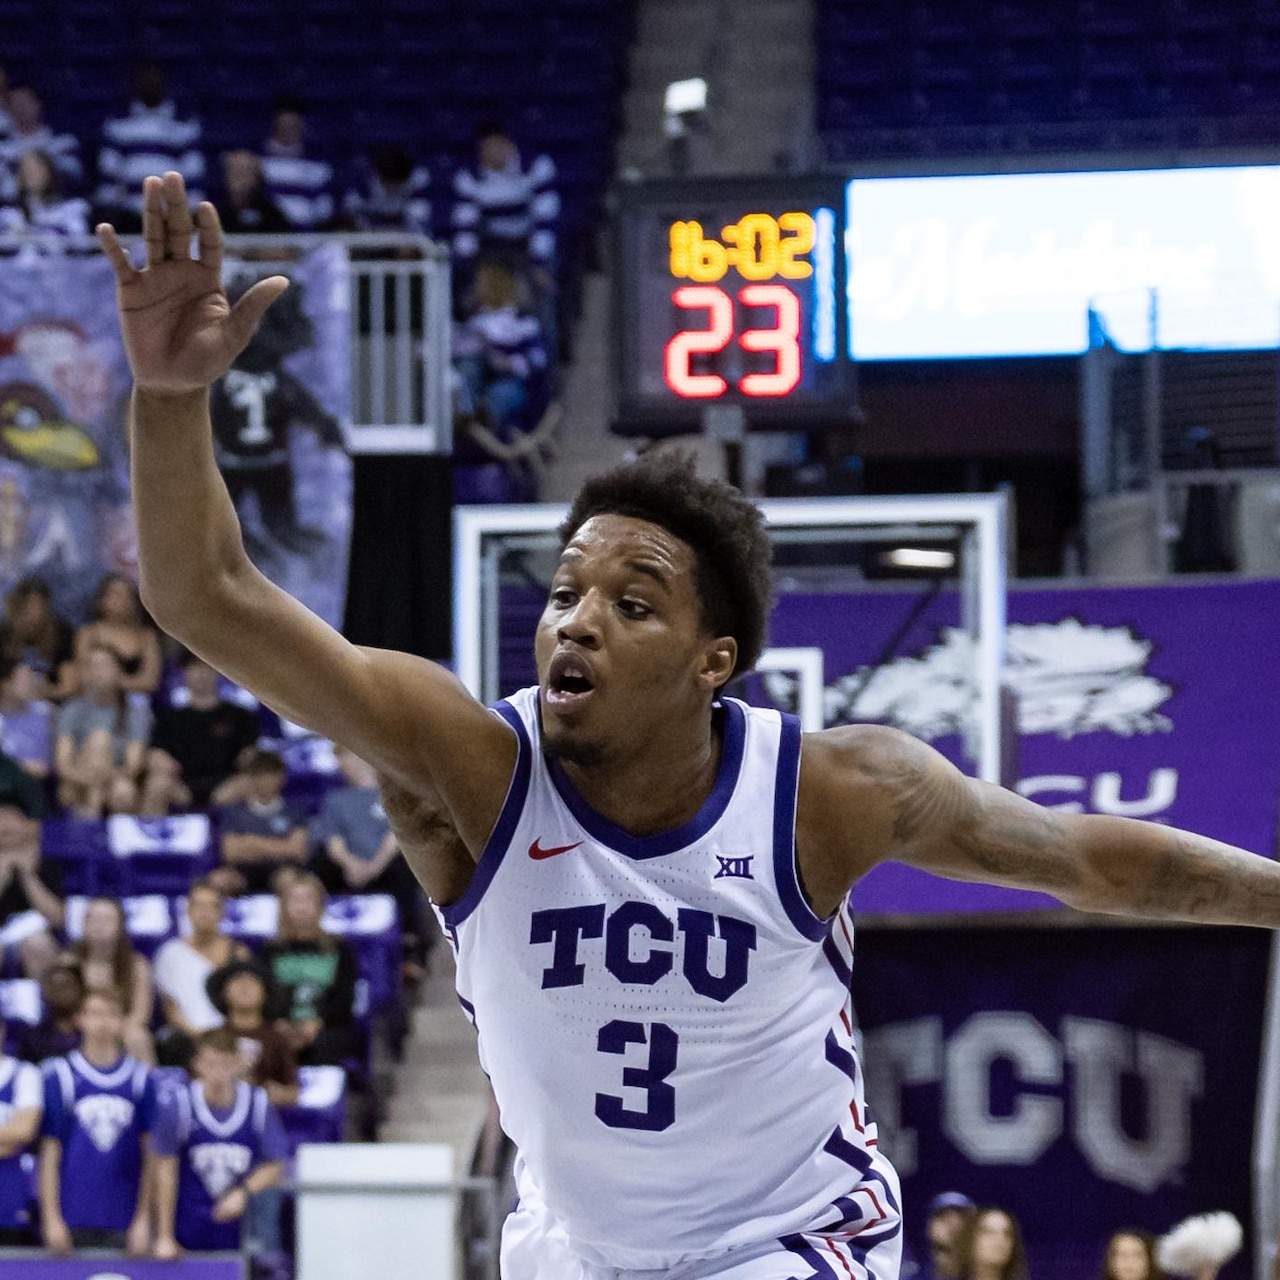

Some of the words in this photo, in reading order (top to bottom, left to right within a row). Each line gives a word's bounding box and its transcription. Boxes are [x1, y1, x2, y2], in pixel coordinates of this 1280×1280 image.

[669, 213, 817, 282] 16:02
[664, 284, 802, 398] 23
[1015, 768, 1179, 816] CU
[713, 854, 755, 880] XII
[529, 901, 758, 1003] TCU
[594, 1018, 679, 1132] 3
